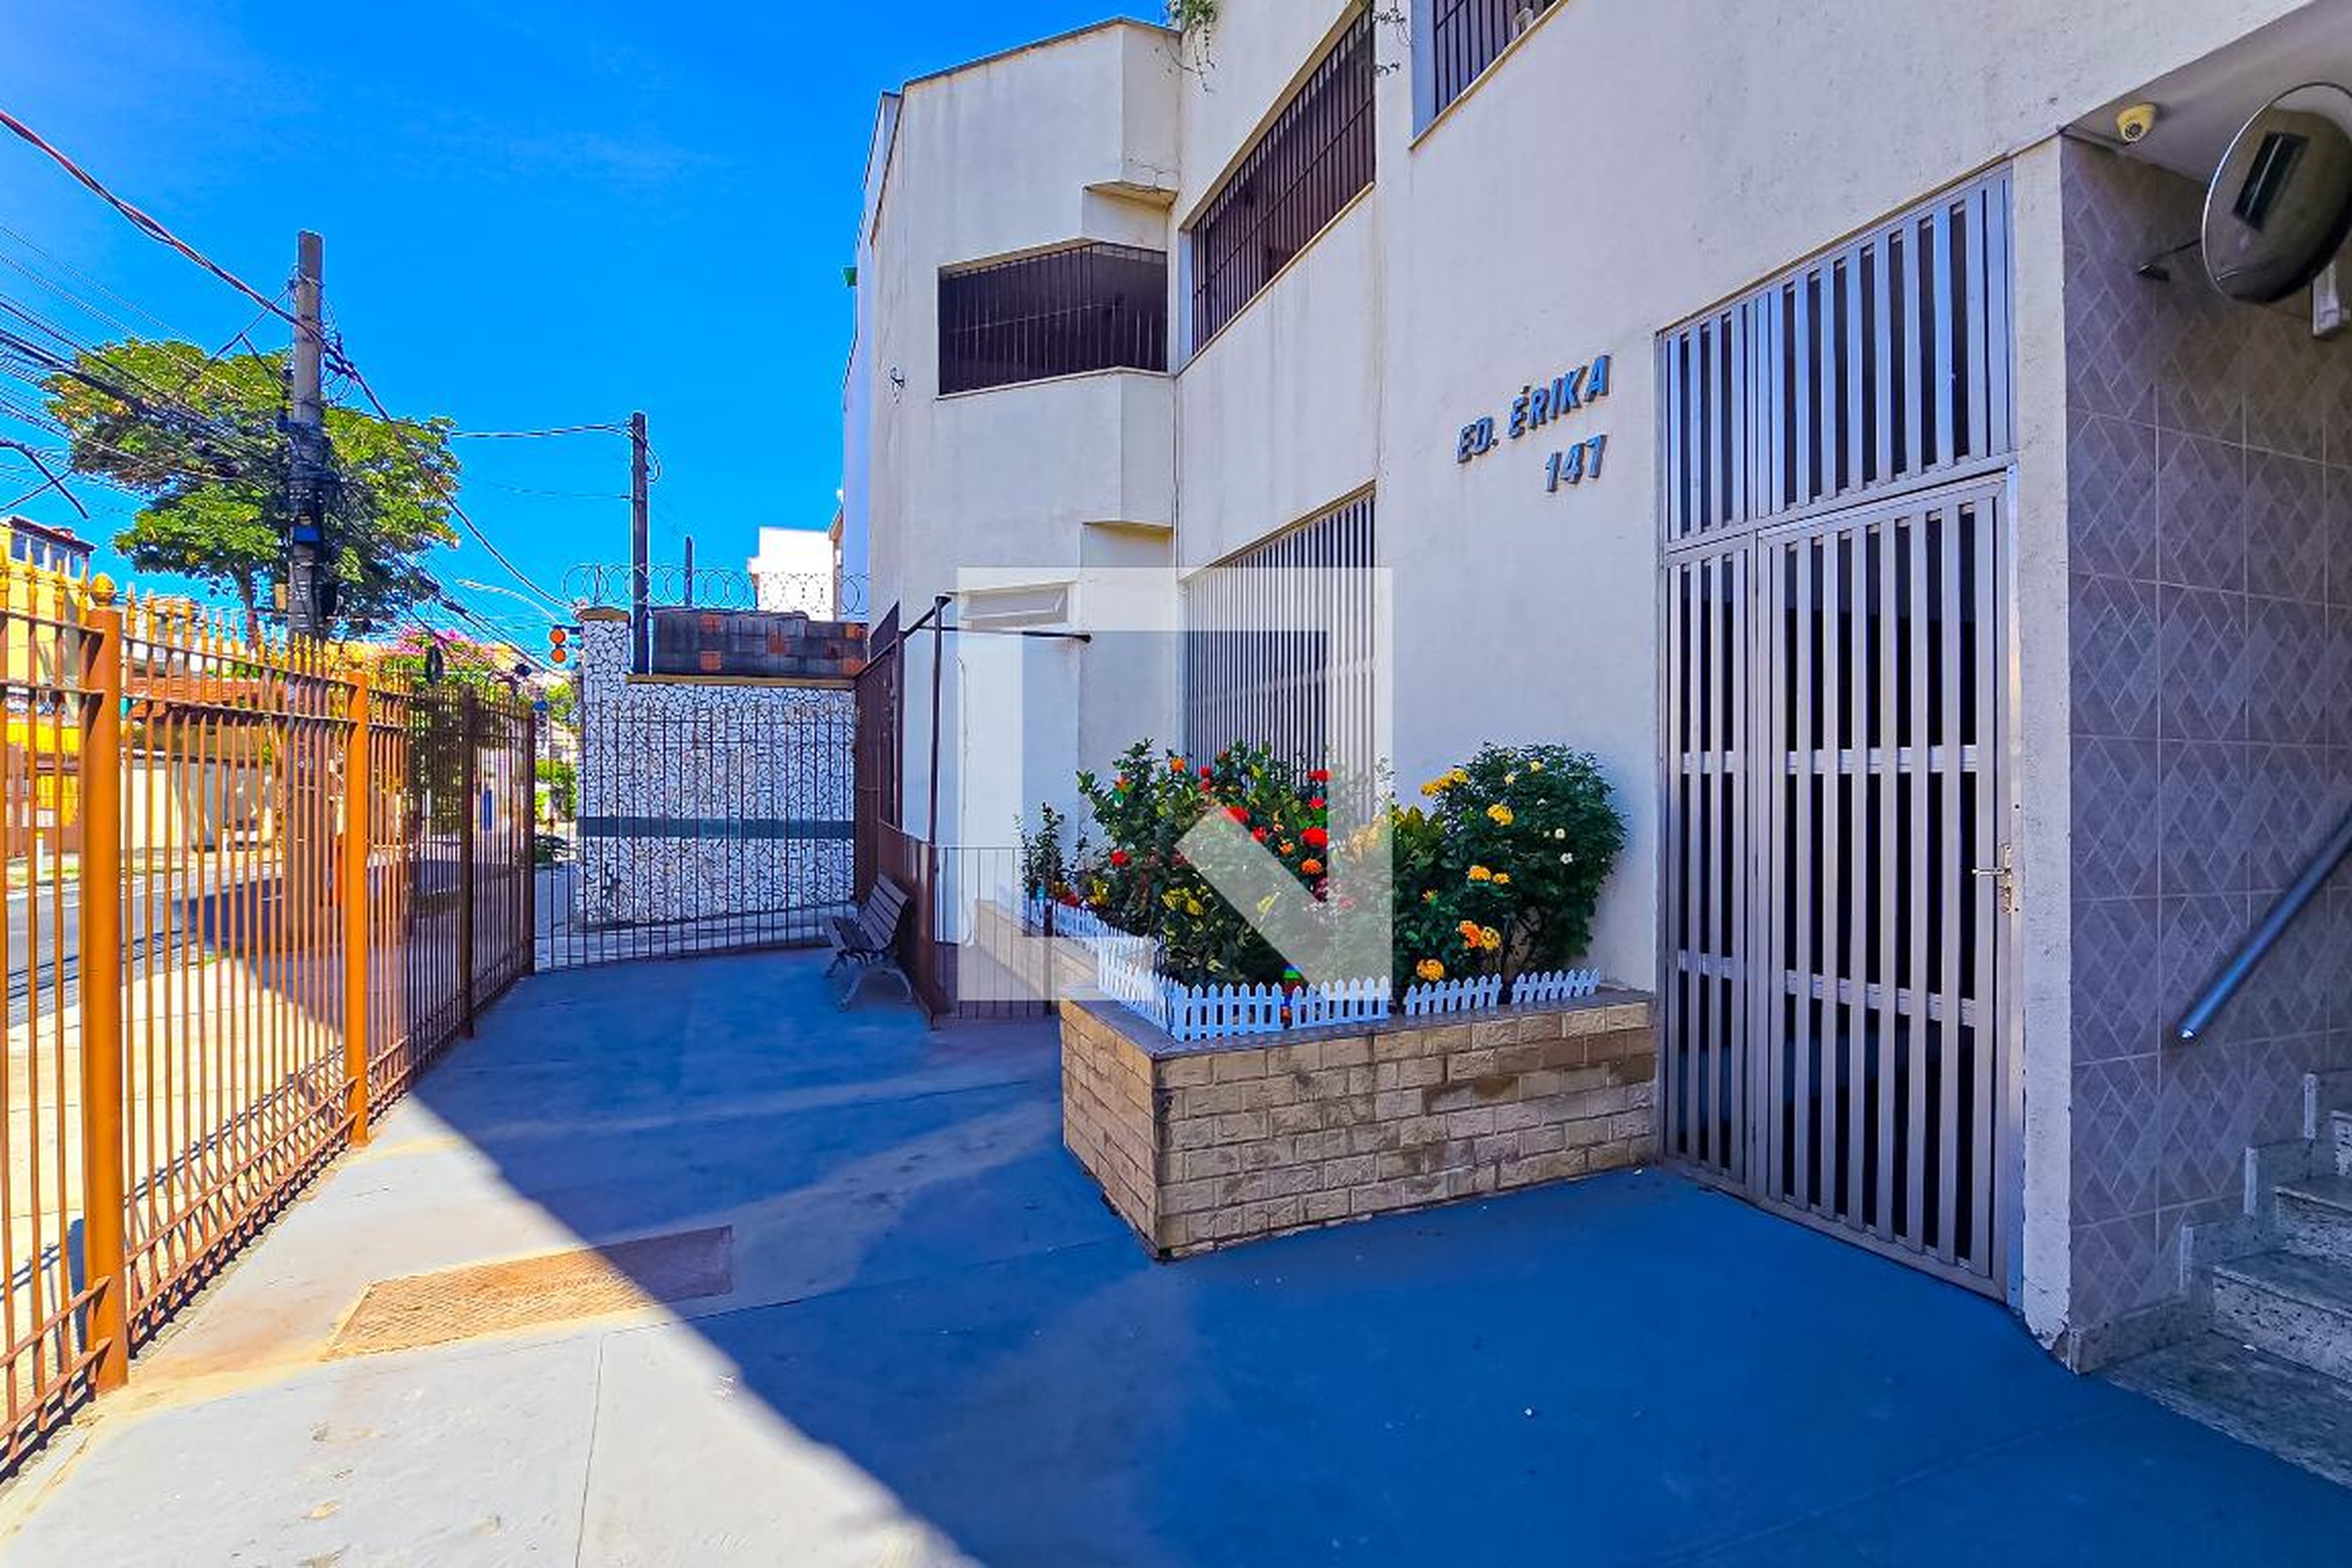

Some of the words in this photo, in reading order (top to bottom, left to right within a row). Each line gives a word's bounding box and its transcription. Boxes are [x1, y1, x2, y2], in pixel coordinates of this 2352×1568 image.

[1457, 417, 1499, 464] ED.
[1508, 355, 1611, 439] ÉRIKA
[1545, 434, 1608, 492] 147
